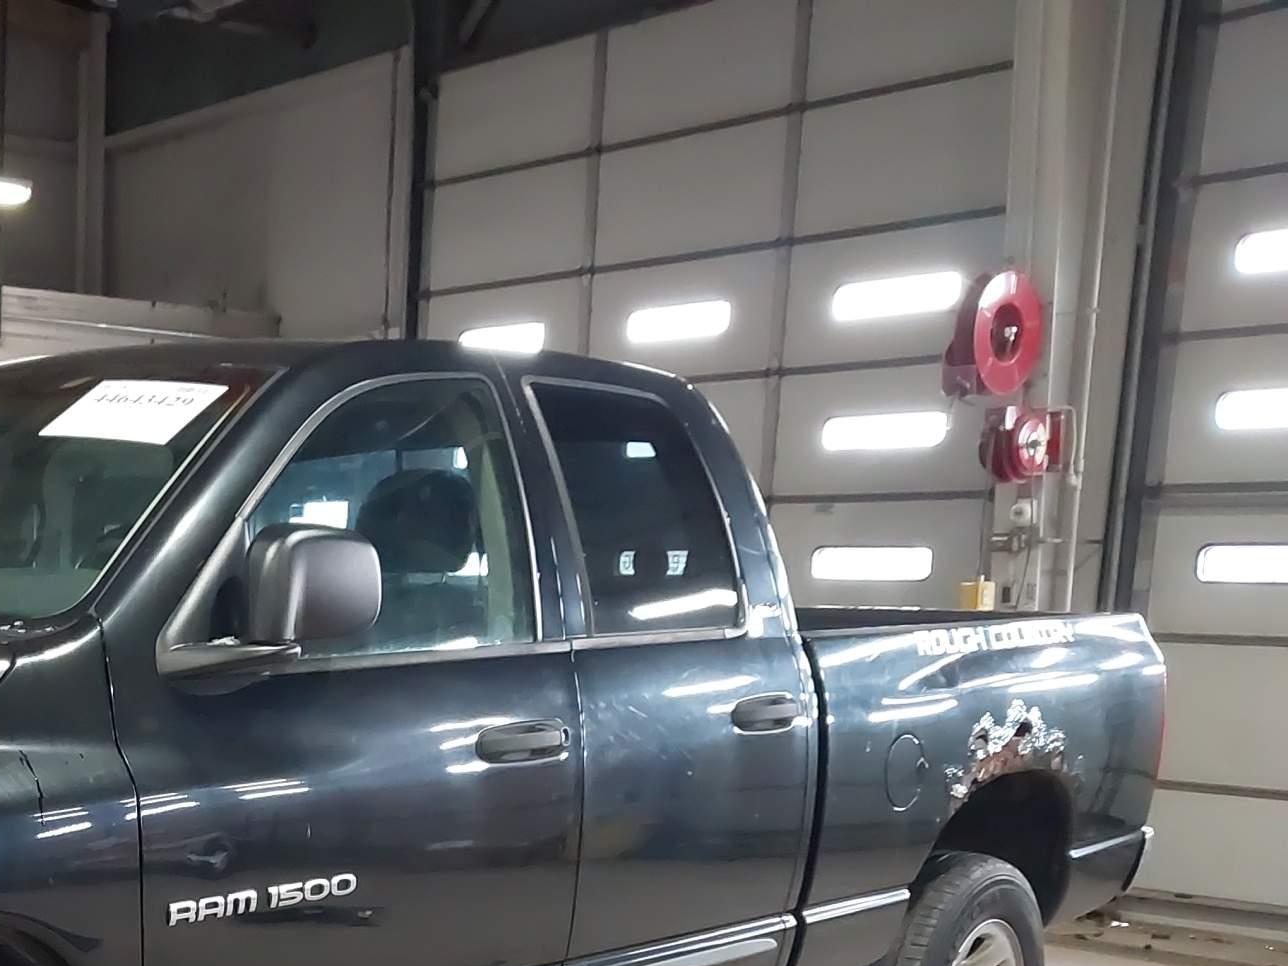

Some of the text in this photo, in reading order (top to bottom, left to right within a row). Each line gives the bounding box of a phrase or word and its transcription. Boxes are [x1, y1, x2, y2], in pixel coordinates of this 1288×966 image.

[913, 626, 988, 656] ROUGH
[168, 873, 357, 926] RAM 1500
